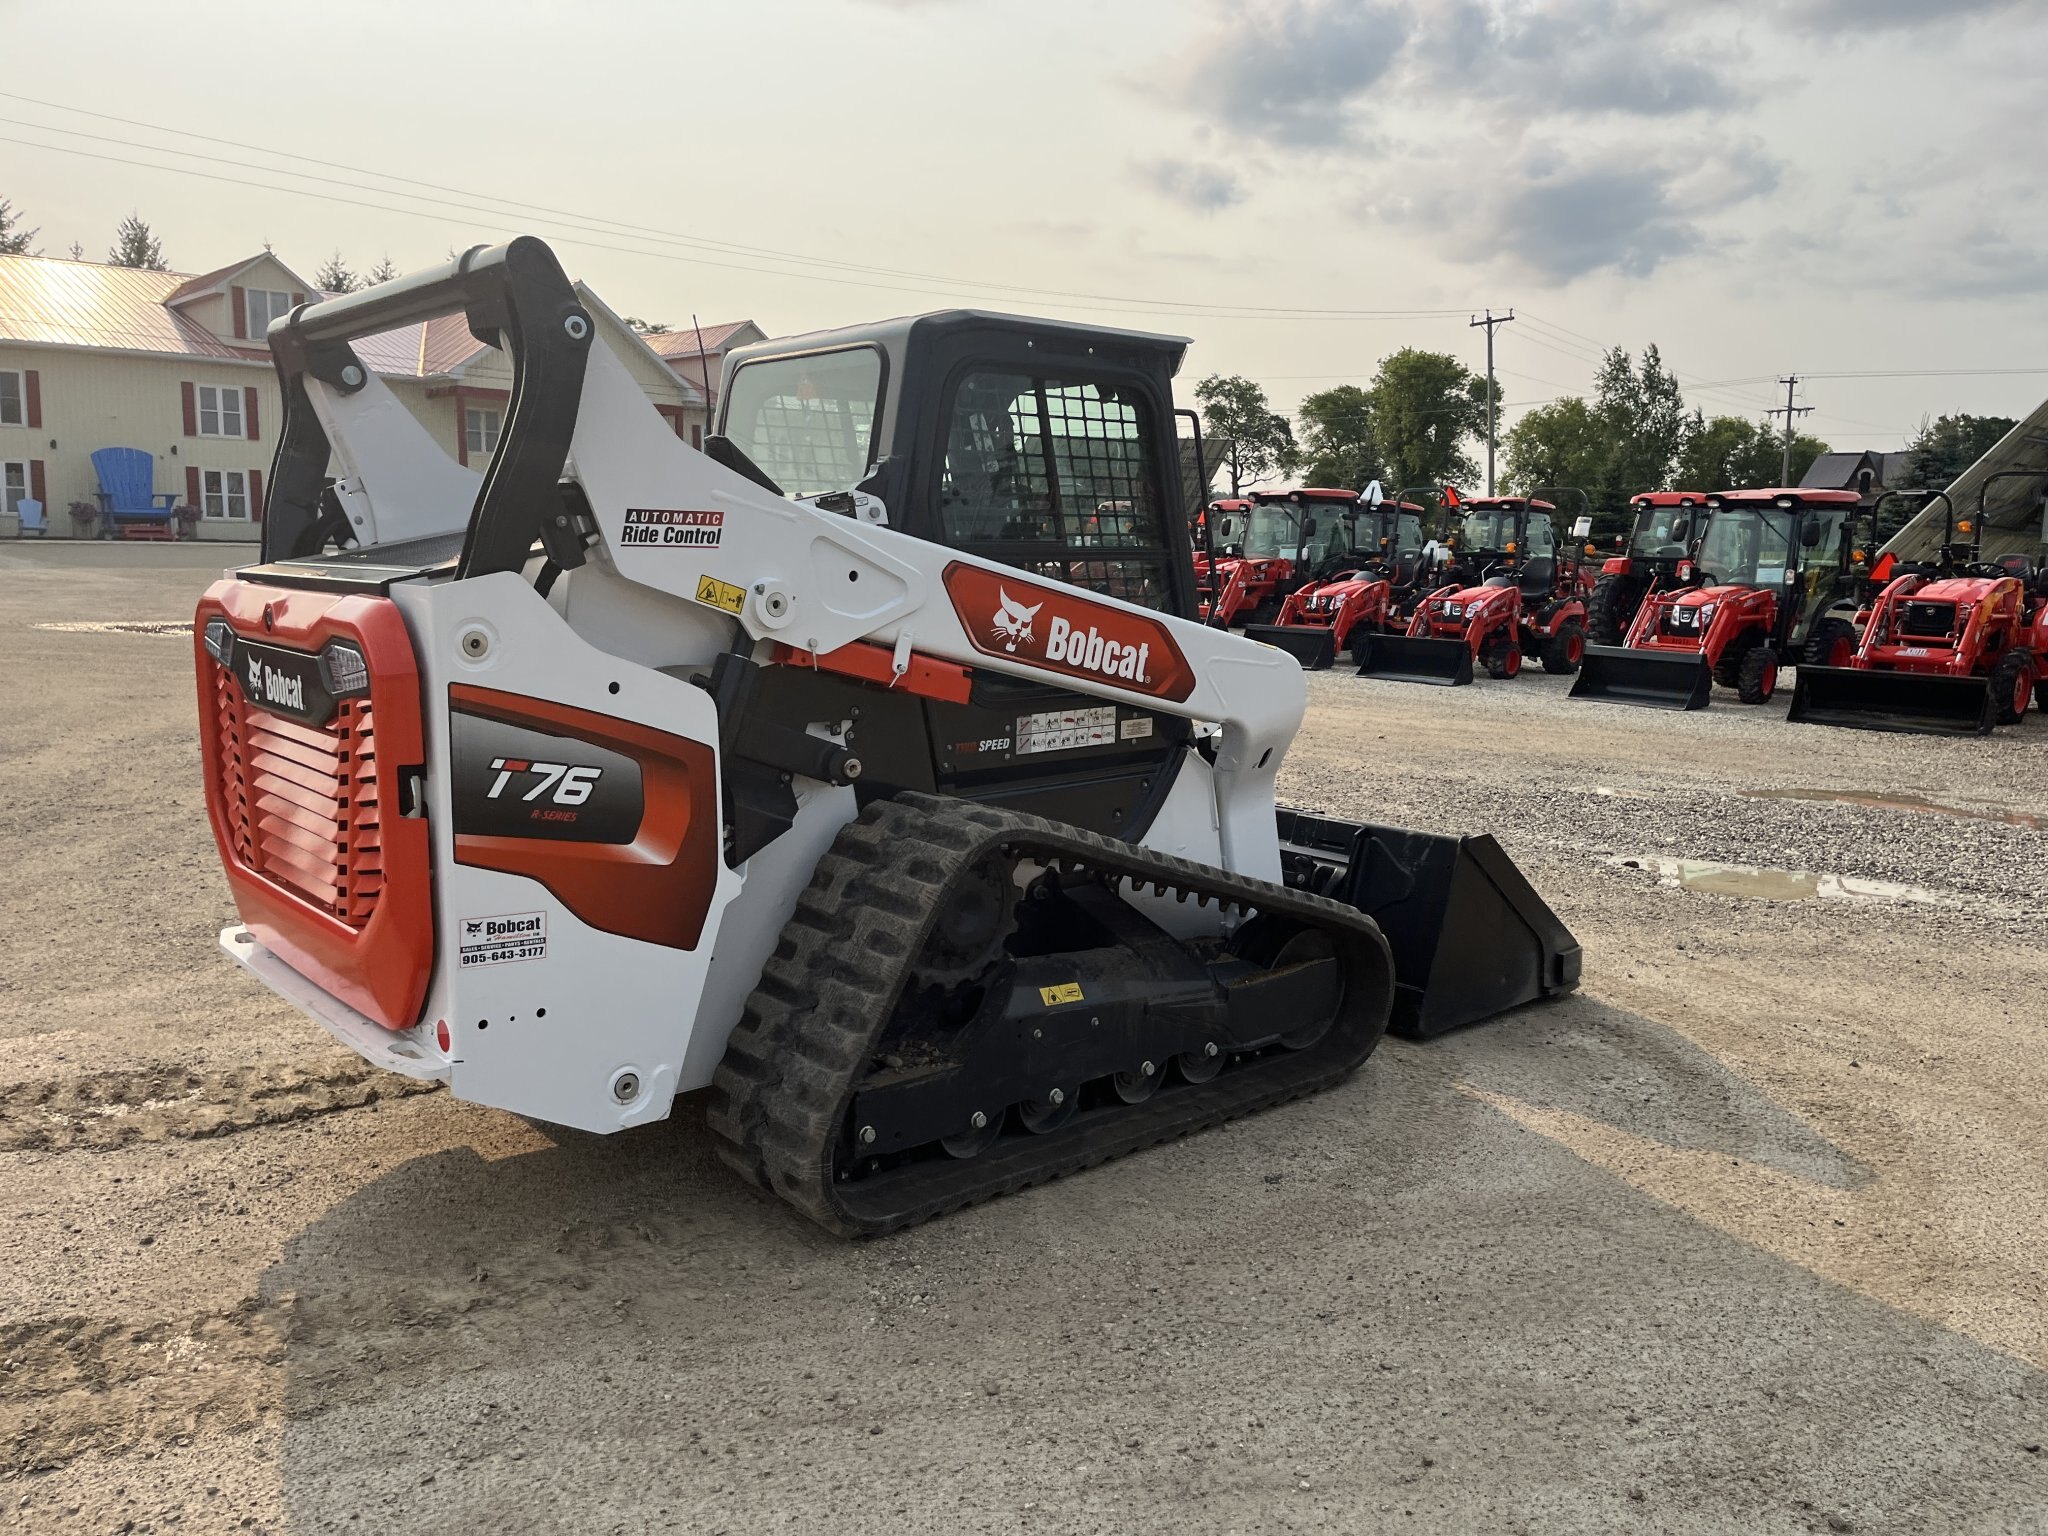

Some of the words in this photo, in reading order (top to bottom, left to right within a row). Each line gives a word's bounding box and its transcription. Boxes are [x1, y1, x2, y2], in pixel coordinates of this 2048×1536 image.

[629, 511, 720, 525] AUTOMATIC
[621, 525, 659, 543] Ride
[663, 526, 722, 545] Control
[1045, 615, 1149, 683] Bobcat
[264, 665, 304, 711] Bobcat
[978, 738, 1010, 752] SPEED
[487, 758, 602, 806] T76
[530, 809, 578, 822] R-SERIES
[486, 917, 541, 936] Bobcat
[462, 946, 544, 964] 905-643-3177
